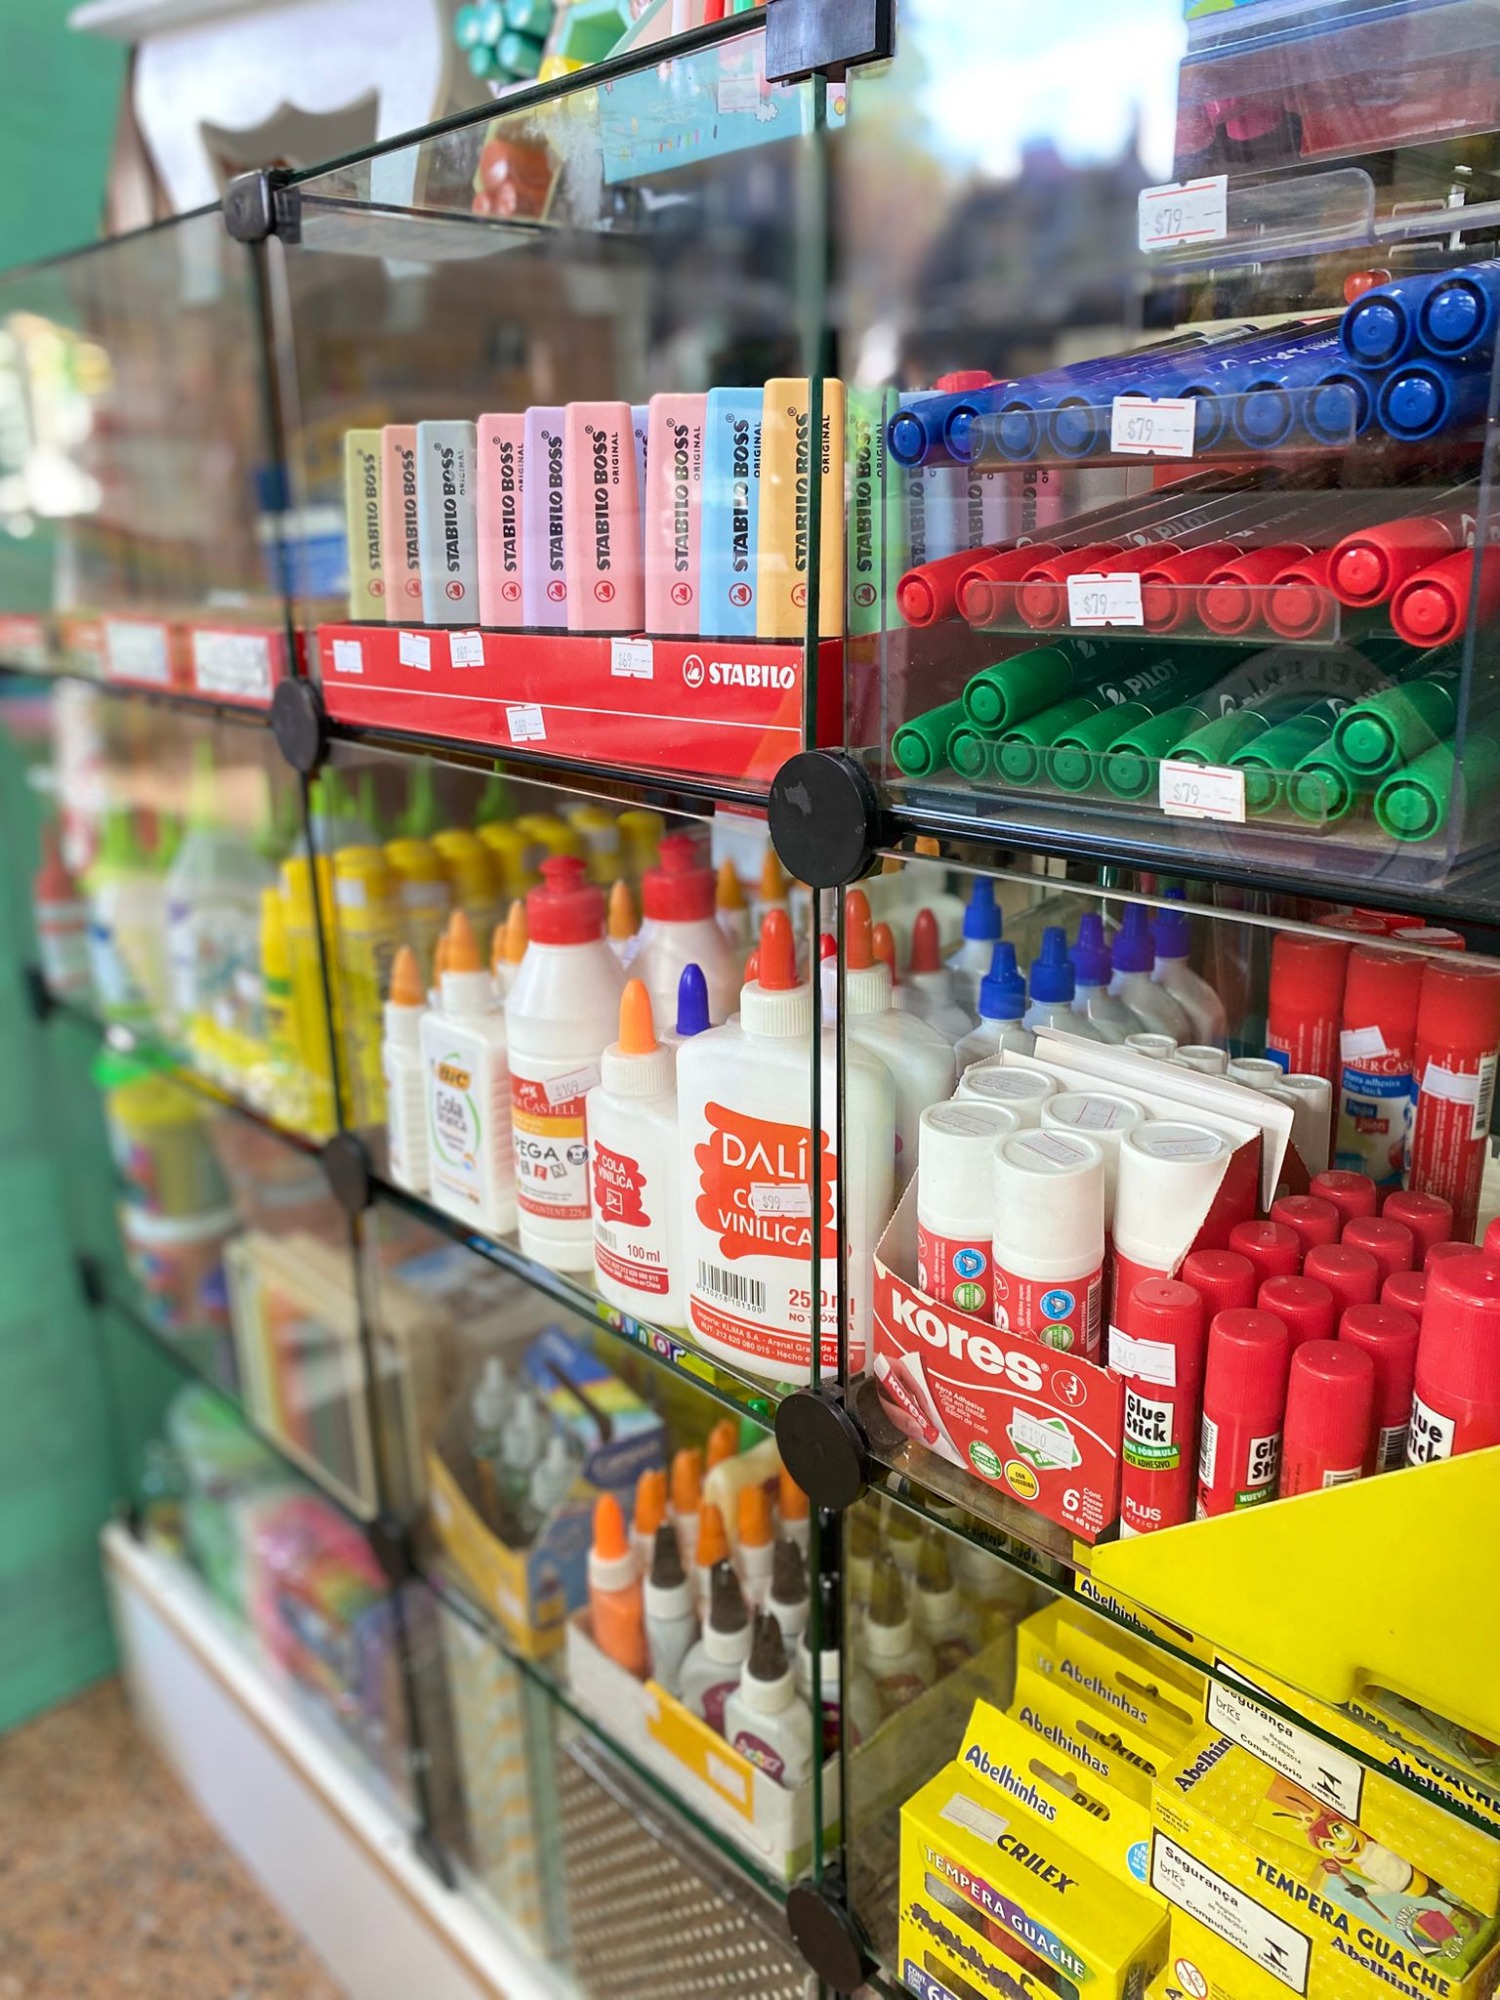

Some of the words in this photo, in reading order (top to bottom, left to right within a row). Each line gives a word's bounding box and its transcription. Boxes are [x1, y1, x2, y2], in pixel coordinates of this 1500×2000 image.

[1155, 207, 1184, 234] $79
[674, 424, 689, 480] BOSS
[734, 420, 750, 478] BOSS
[822, 414, 830, 474] ORIGINAL
[1127, 419, 1154, 440] $79
[364, 454, 378, 498] BOSS
[402, 450, 416, 498] BOSS
[441, 447, 456, 497] BOSS
[500, 442, 514, 492] BOSS
[548, 436, 562, 488] BOSS
[593, 430, 608, 484] BOSS
[367, 503, 381, 570] STABILO
[404, 498, 420, 570] STABILO
[444, 498, 460, 572] STABILO
[502, 494, 517, 572] STABILO
[549, 491, 564, 571] STABILO
[594, 487, 610, 570] STABILO
[674, 484, 689, 572] STABILO
[733, 481, 749, 572] STABILO
[856, 482, 872, 572] STABILO
[1083, 594, 1107, 614] $79
[708, 662, 795, 690] STABILO
[1123, 658, 1178, 696] PILOT
[1173, 783, 1199, 804] $79
[556, 1080, 579, 1098] $109
[602, 1155, 626, 1175] COLA
[722, 1131, 806, 1180] DALÍ
[762, 1194, 781, 1210] $99
[627, 1244, 644, 1260] 100
[646, 1250, 660, 1262] ml
[789, 1313, 805, 1322] NO
[768, 1336, 794, 1350] Arenal
[776, 1350, 803, 1362] Hecho
[1126, 1413, 1166, 1442] Stick
[1127, 1394, 1166, 1423] Glue
[1138, 1444, 1178, 1458] FÓRMULA
[1138, 1458, 1170, 1469] ADHESIVO
[1063, 1488, 1080, 1512] 6
[1126, 1496, 1162, 1522] PLUS
[1060, 1659, 1148, 1725] Abelhinhas
[1019, 1706, 1110, 1777] Abelhinhas
[1240, 1733, 1303, 1780] Compulsório
[965, 1745, 1058, 1822] Abelhinhas
[997, 1834, 1076, 1894] CRILEX
[1166, 1846, 1238, 1907] Segurança
[925, 1846, 1005, 1920] TEMPERA
[1011, 1914, 1086, 1981] GUACHE
[1186, 1900, 1249, 1950] Compulsório
[1256, 1857, 1349, 1936] TEMPERA
[1357, 1928, 1450, 1998] GUACHE
[1396, 1905, 1418, 1931] PINTA
[907, 1964, 927, 1986] CONT.
